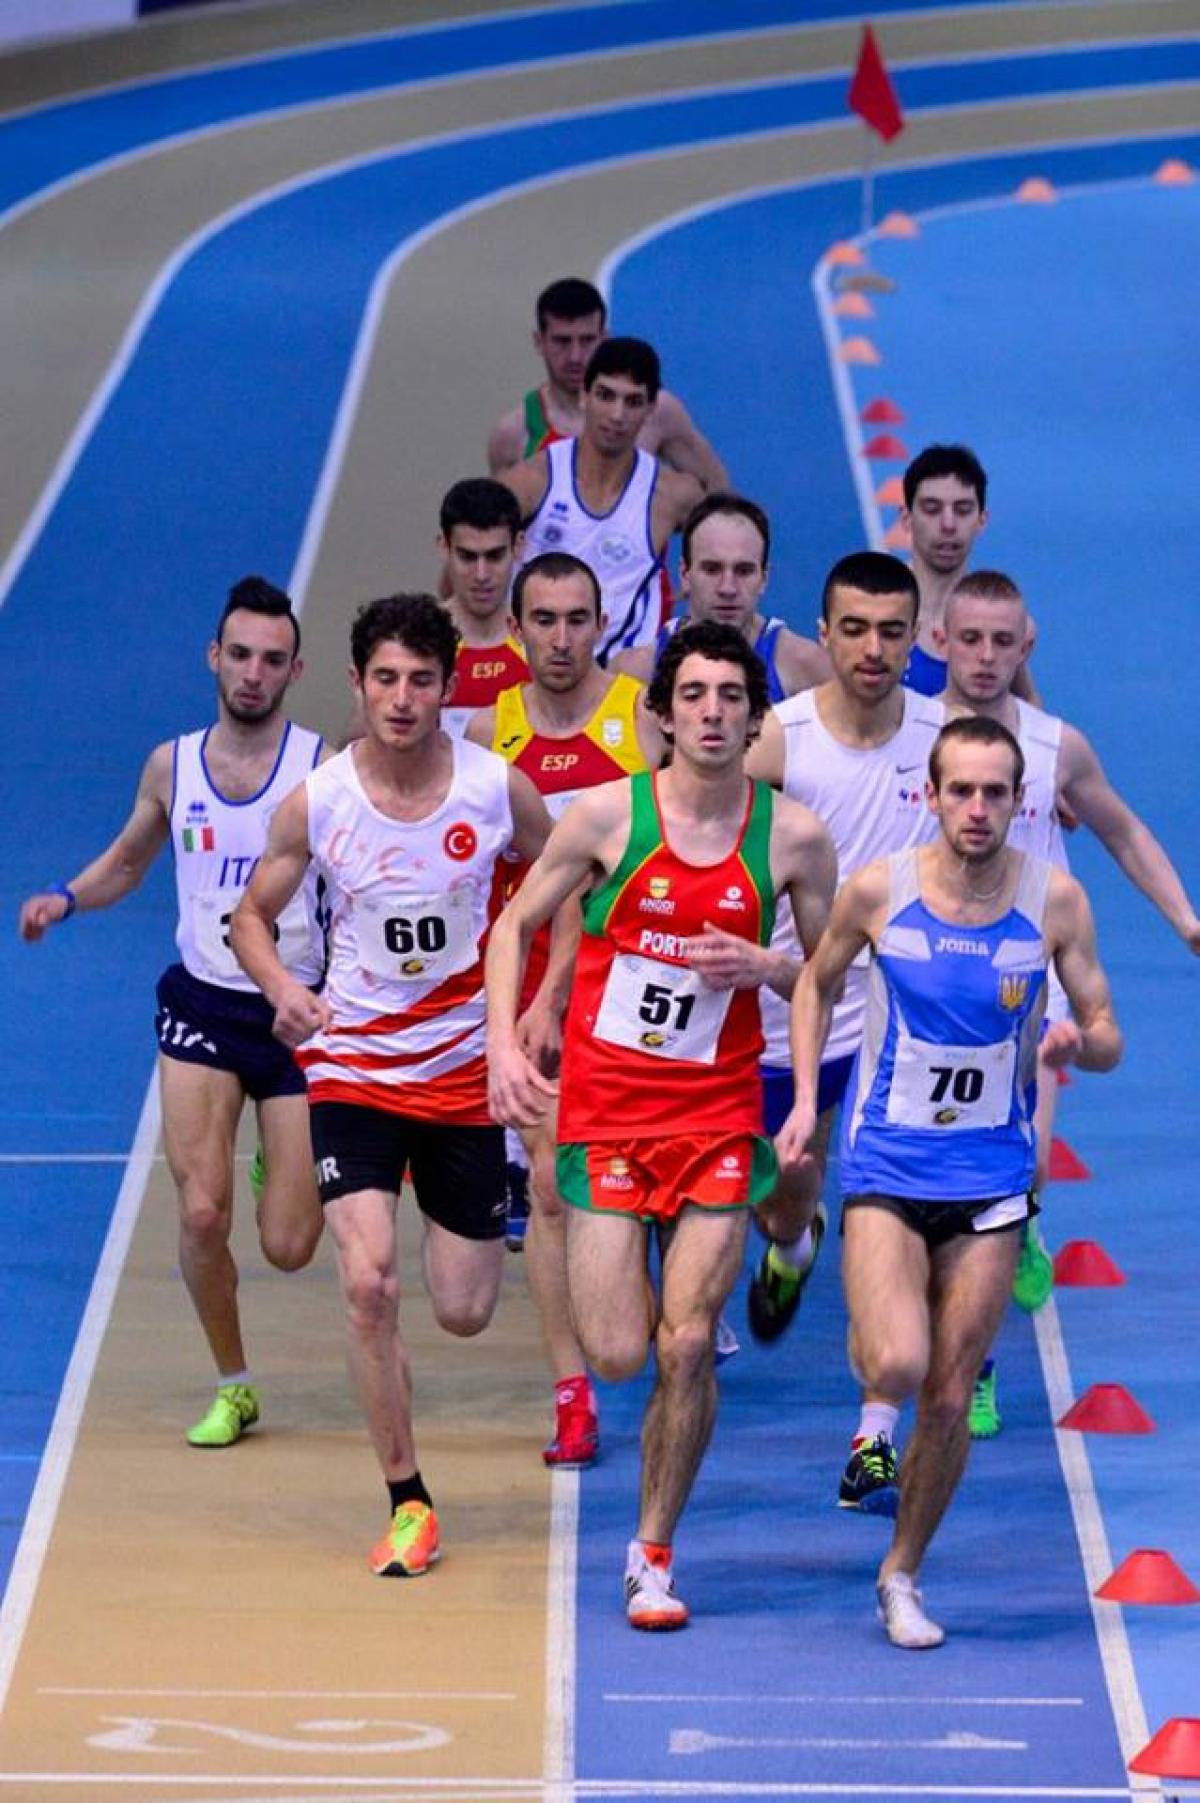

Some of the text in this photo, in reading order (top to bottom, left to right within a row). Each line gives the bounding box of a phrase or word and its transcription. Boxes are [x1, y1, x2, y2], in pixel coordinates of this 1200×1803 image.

[472, 662, 506, 679] ESP
[540, 754, 579, 771] ESP
[384, 916, 446, 953] 60
[639, 929, 690, 957] PORT
[639, 983, 695, 1031] 51
[929, 1066, 984, 1104] 70
